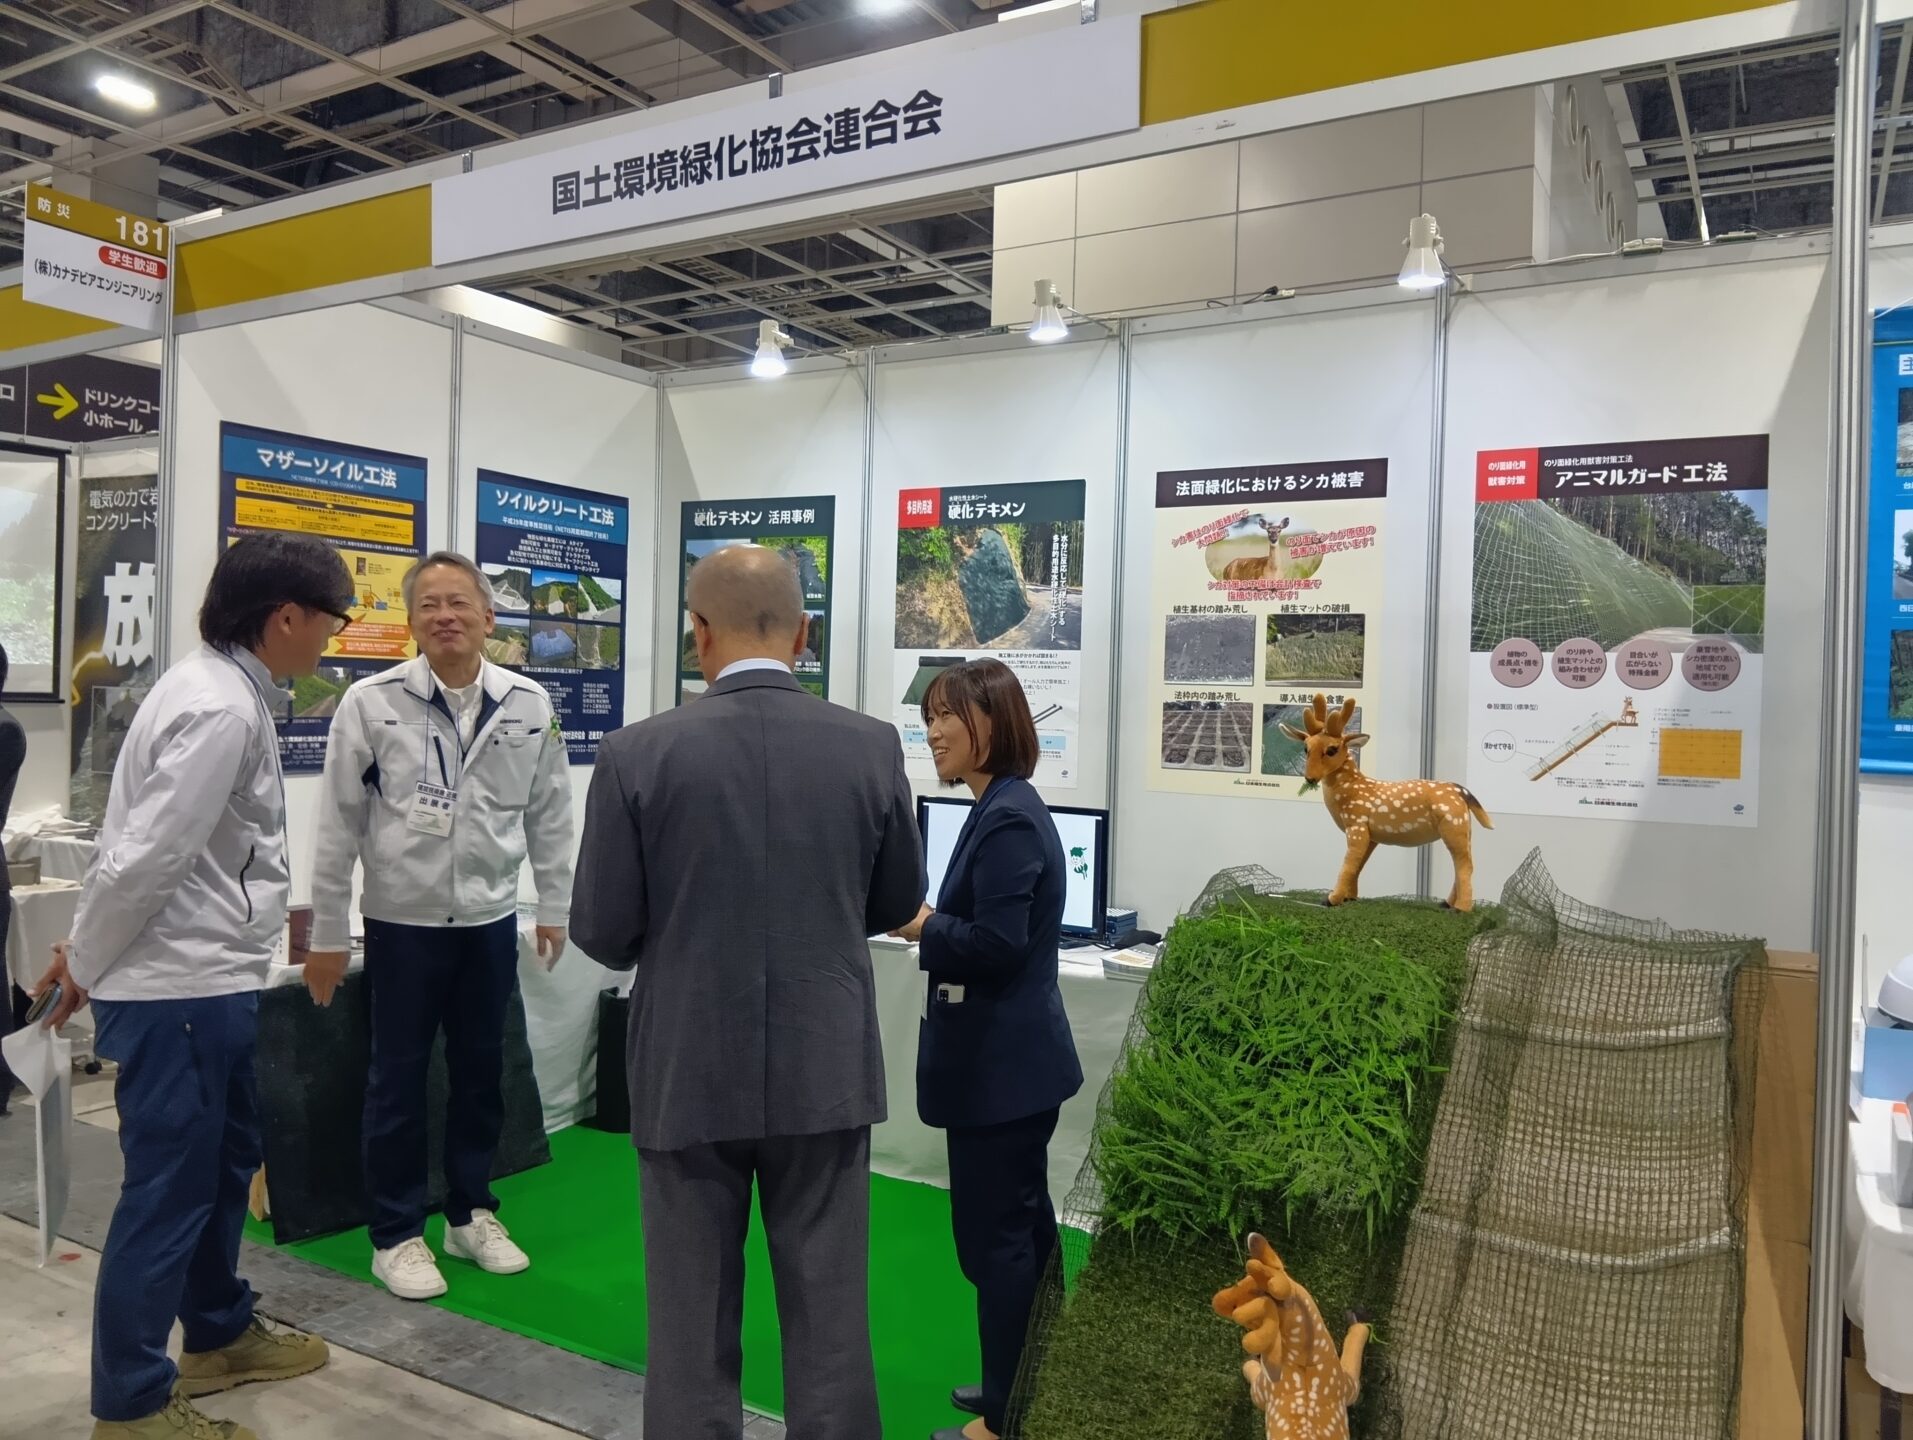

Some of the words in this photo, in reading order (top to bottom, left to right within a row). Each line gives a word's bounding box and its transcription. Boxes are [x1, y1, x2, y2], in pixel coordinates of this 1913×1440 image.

[552, 89, 943, 215] 国土環境緑化協会連合会
[37, 196, 71, 219] 防災
[115, 215, 164, 252] 181
[108, 249, 159, 277] 学生歓迎
[83, 410, 143, 433] 小ホール
[256, 448, 398, 489] マザーソイル工法
[1555, 465, 1677, 489] アニマルガード
[1682, 462, 1728, 483] 工法
[1176, 471, 1364, 497] 法面緑化におけるシカ被害
[1488, 475, 1526, 487] 獣害対策
[496, 489, 615, 526] ソイルクリート工法
[694, 511, 763, 527] 硬化テキメン
[768, 509, 815, 525] 活用事例
[948, 502, 1026, 520] 硬化テキメン
[1173, 605, 1248, 614] 植生基材の踏み荒し
[1281, 604, 1351, 614] 植生マットの破損
[1558, 665, 1601, 673] 組み合わせが
[1174, 691, 1241, 701] 法枠内の踏み荒し
[1280, 693, 1344, 705] 導入植生食害
